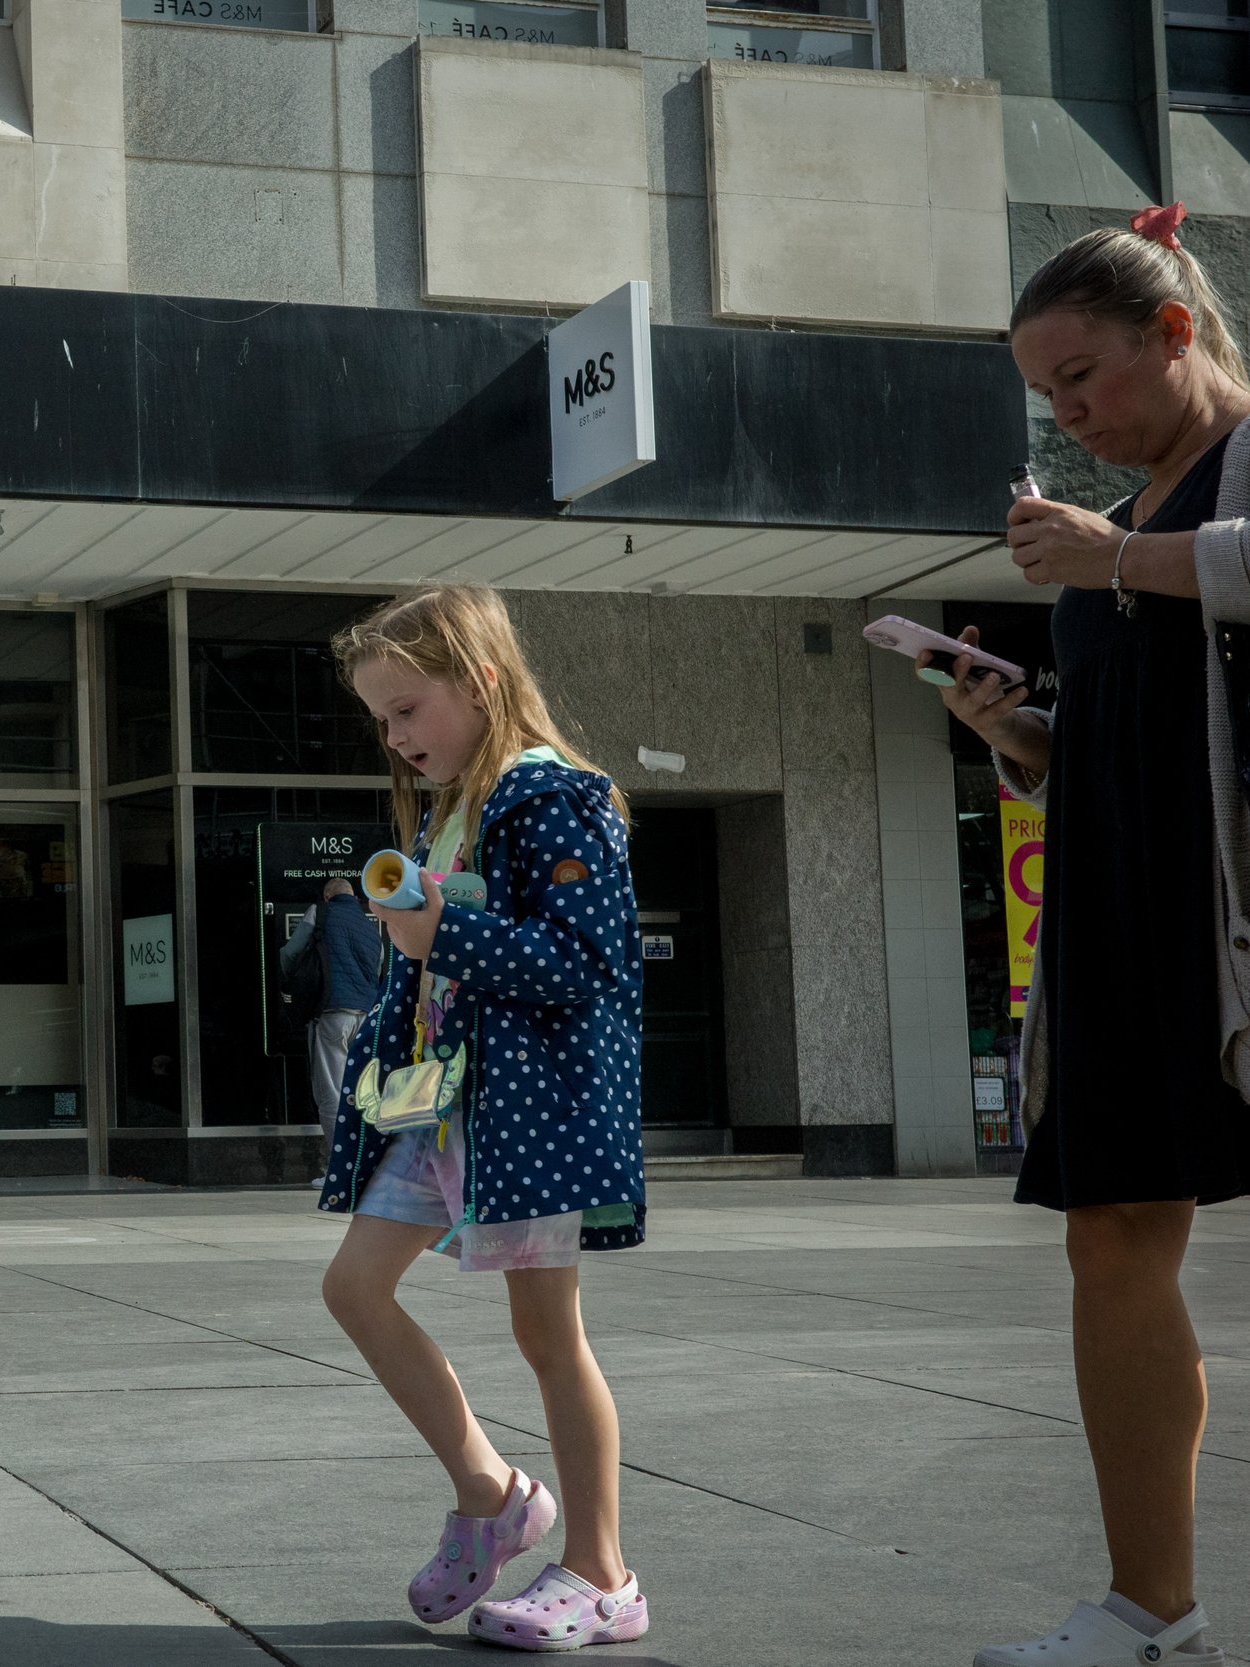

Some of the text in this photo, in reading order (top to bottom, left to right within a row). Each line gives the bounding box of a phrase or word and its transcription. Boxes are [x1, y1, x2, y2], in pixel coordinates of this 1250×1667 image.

[564, 352, 615, 414] M&S
[311, 837, 353, 854] M&S
[283, 869, 303, 878] FREE
[304, 869, 327, 878] CASH
[130, 940, 167, 967] M&S
[976, 1096, 1003, 1105] £3.09
